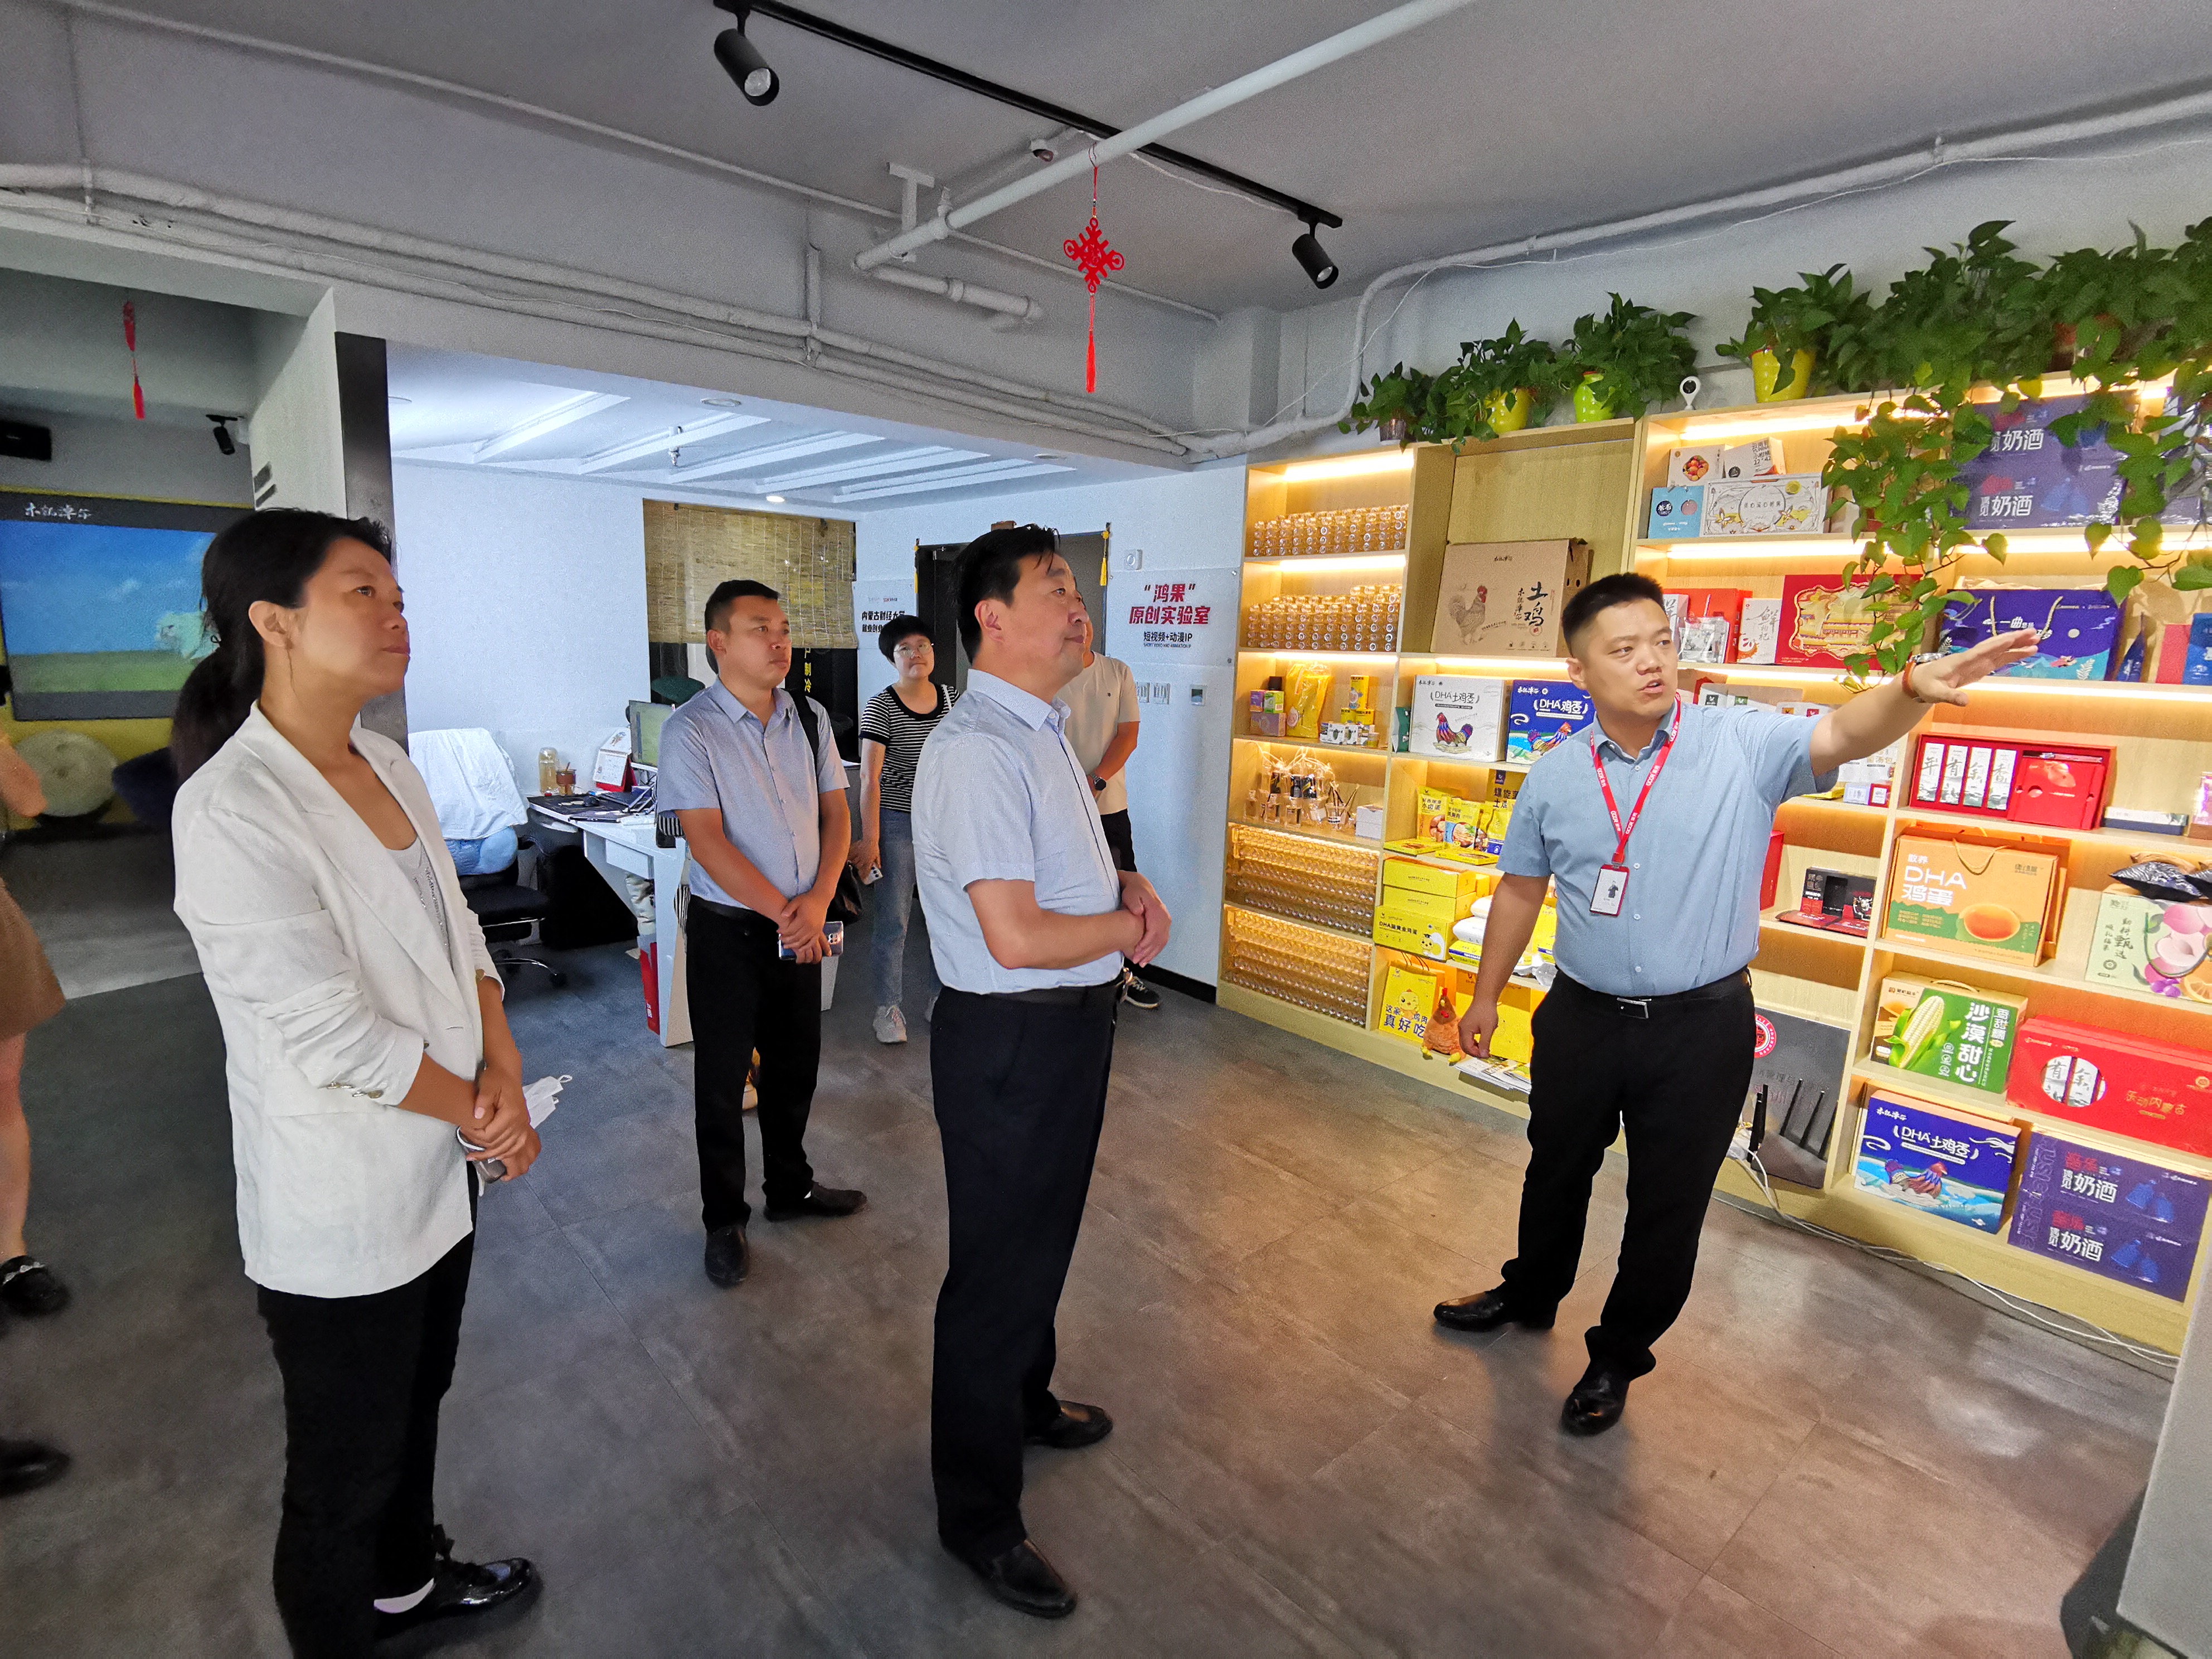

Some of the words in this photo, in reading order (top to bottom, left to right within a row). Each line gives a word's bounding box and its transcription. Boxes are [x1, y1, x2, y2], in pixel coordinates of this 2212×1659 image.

[2002, 428, 2044, 452] 奶酒
[1991, 494, 2034, 517] 奶酒
[1129, 605, 1211, 625] 原创实验室
[1143, 630, 1193, 642] 短视频+动漫IP
[1923, 756, 1939, 775] 年
[1947, 757, 1963, 777] 有
[1908, 853, 1929, 864] 散养
[1904, 865, 1967, 890] DHA
[1901, 884, 1954, 906] 鸡蛋
[1384, 1014, 1426, 1039] 真好吃
[1954, 1002, 1991, 1083] 沙漠甜心
[2074, 1173, 2118, 1203] 奶酒
[2060, 1231, 2104, 1262] 奶酒
